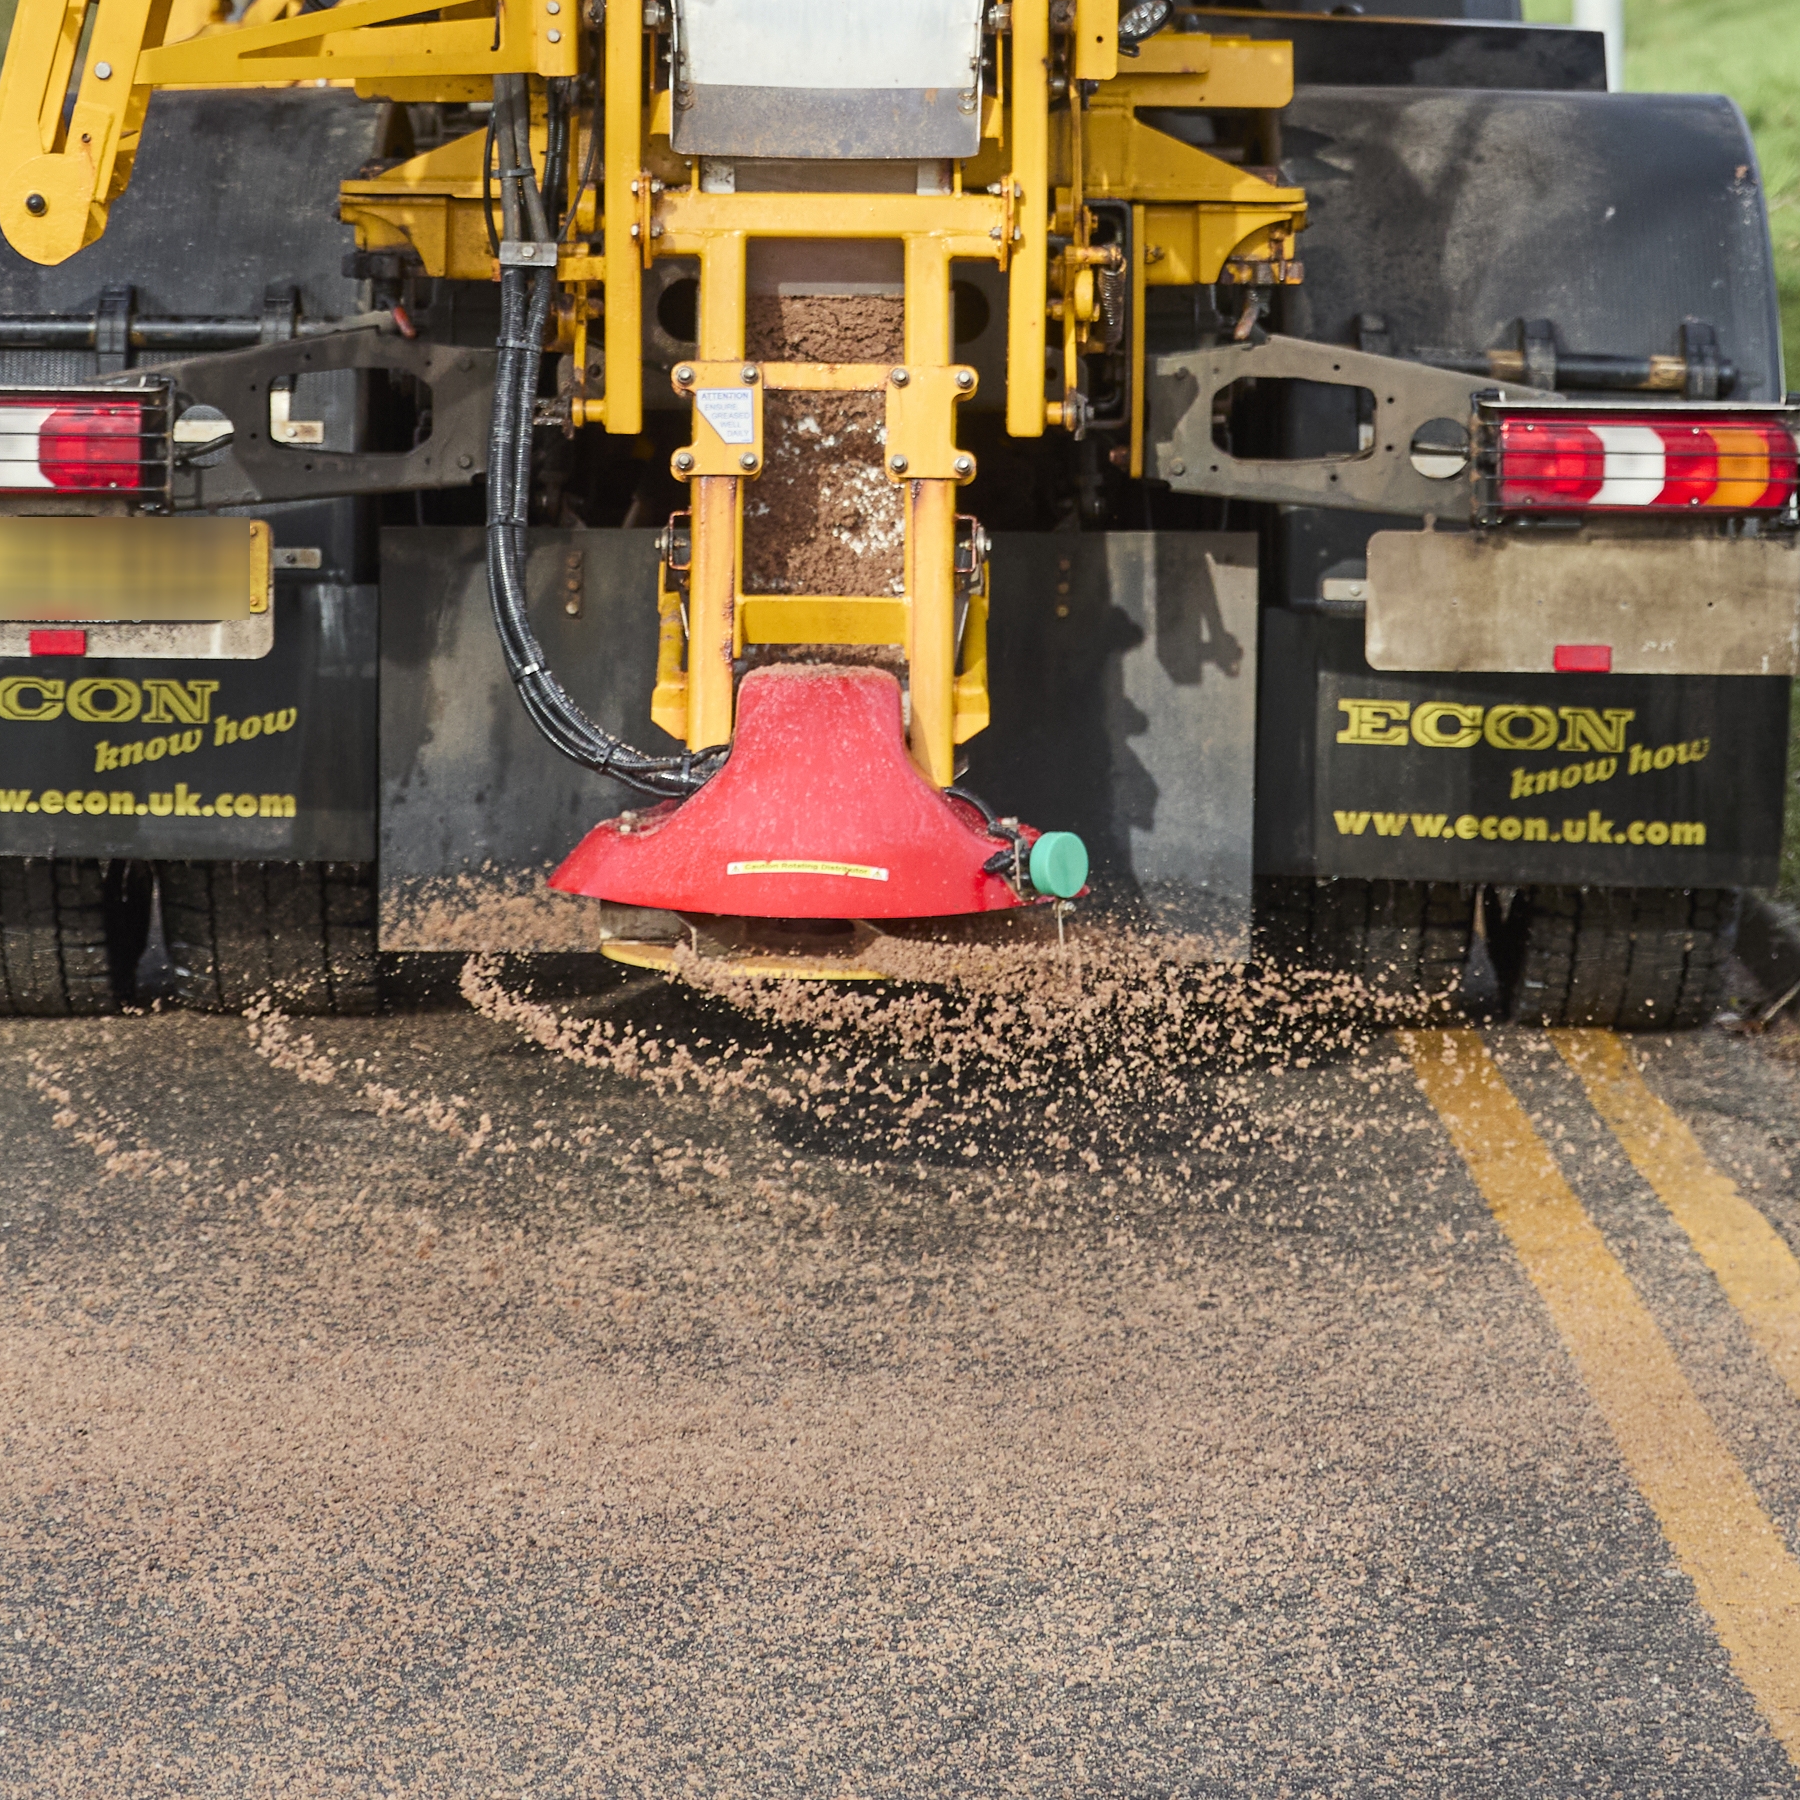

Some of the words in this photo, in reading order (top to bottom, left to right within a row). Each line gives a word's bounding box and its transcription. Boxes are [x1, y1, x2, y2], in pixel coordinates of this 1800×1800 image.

[701, 392, 749, 400] ATTENTION
[94, 724, 203, 773] know
[213, 706, 297, 748] how
[1336, 698, 1636, 753] ECON
[1509, 756, 1618, 800] know
[1627, 738, 1710, 777] how
[1332, 809, 1707, 846] www.econ.uk.com
